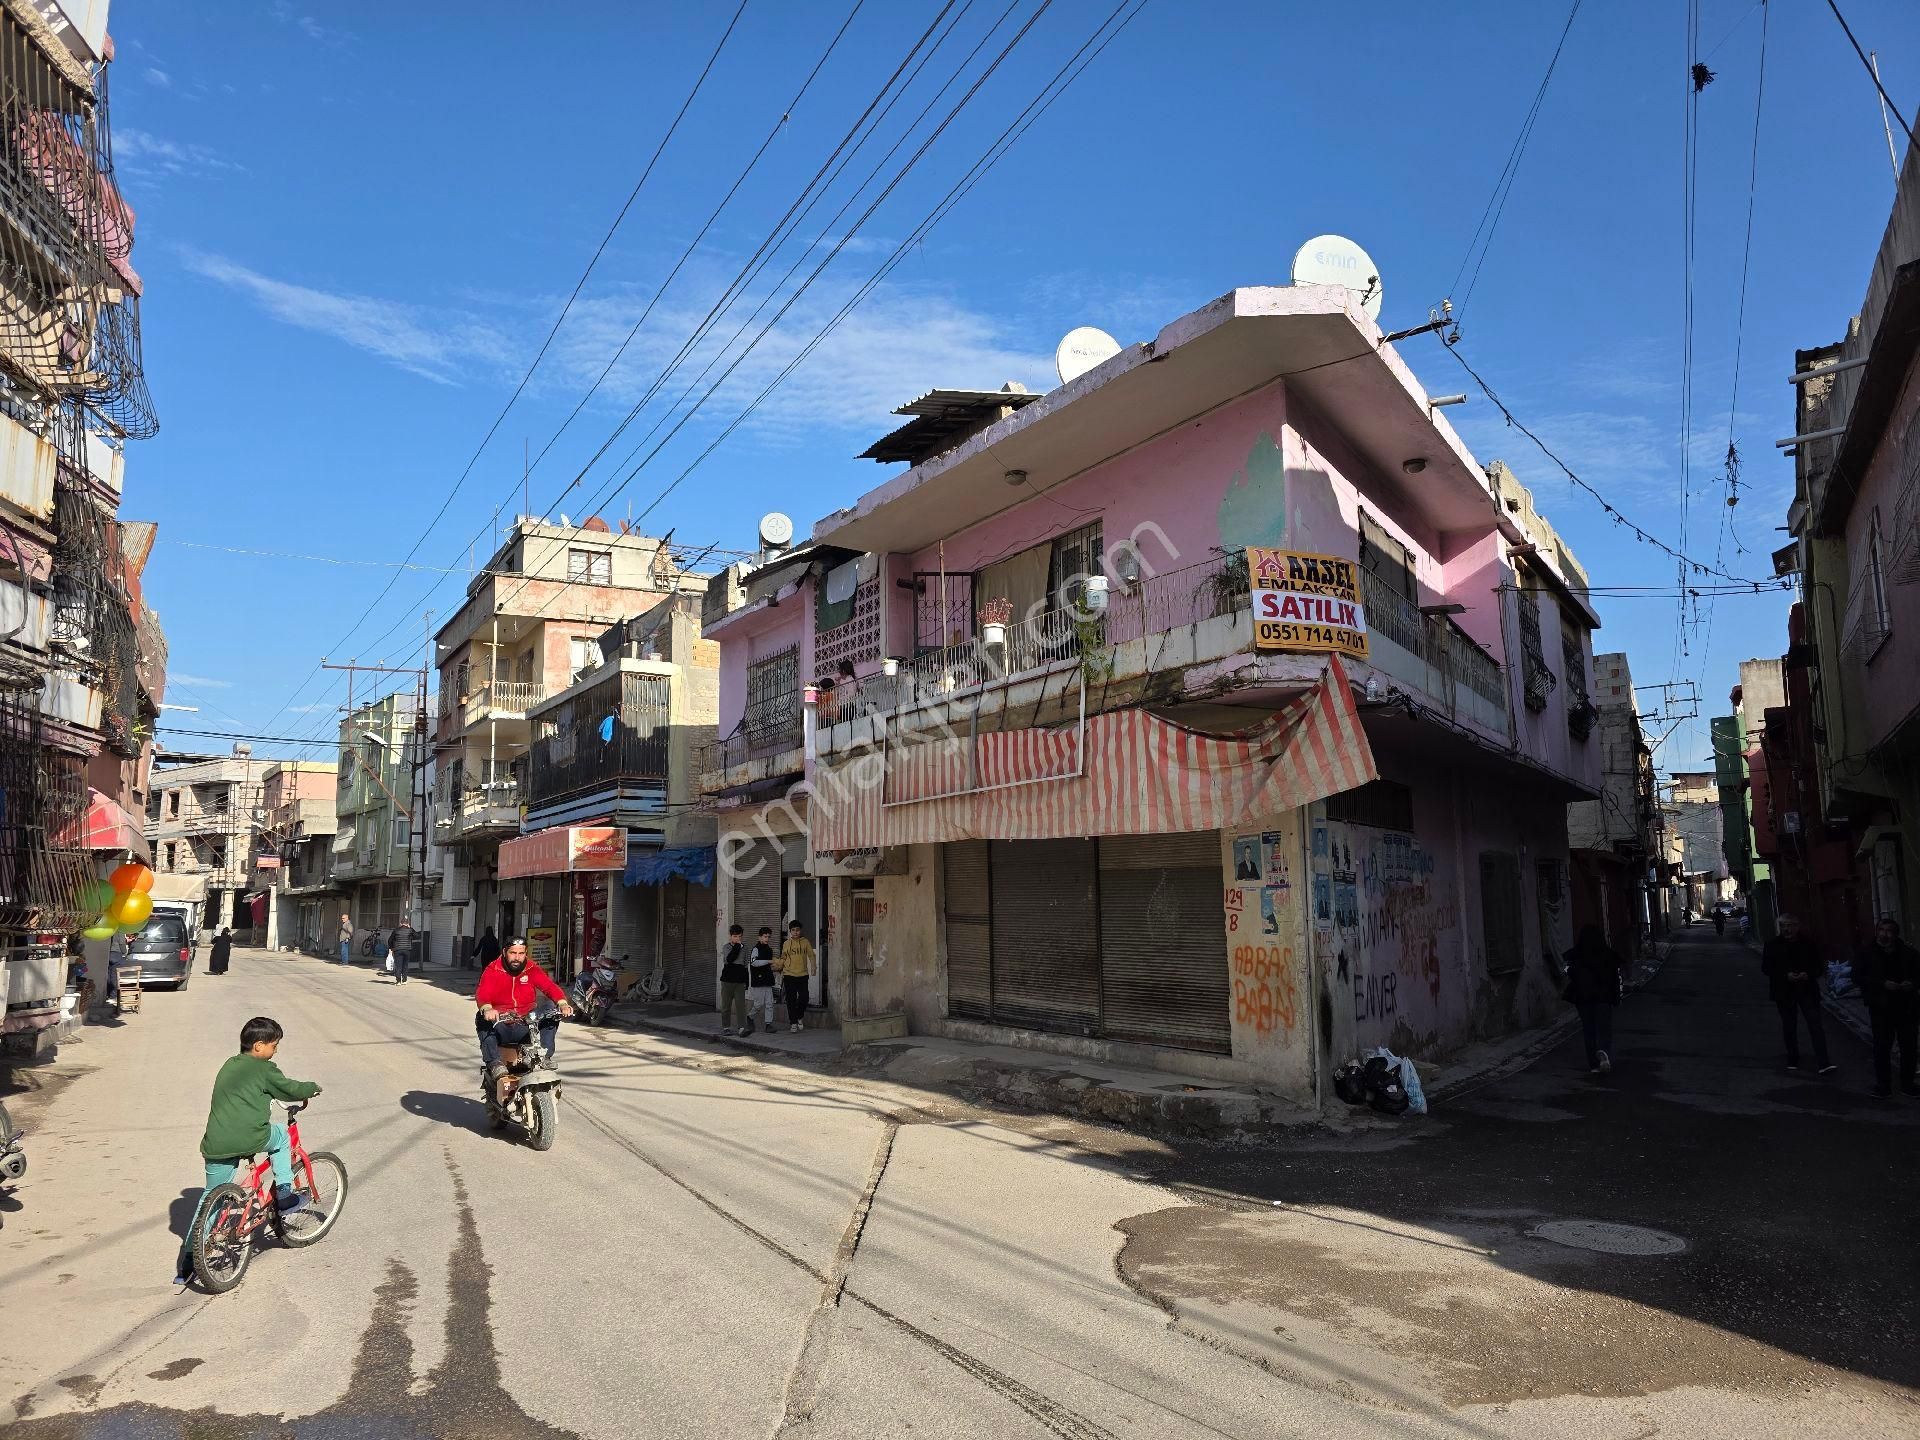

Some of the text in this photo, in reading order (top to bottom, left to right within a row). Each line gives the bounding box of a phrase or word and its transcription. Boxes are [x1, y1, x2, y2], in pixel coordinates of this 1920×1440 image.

[1258, 578, 1356, 602] EMLAK'TAN
[1261, 593, 1358, 629] SATILIK
[1260, 623, 1300, 641] 0551
[1303, 626, 1334, 644] 714
[1225, 888, 1243, 907] 129
[1234, 945, 1292, 984] ABBAS
[1353, 972, 1398, 1022] ENVER
